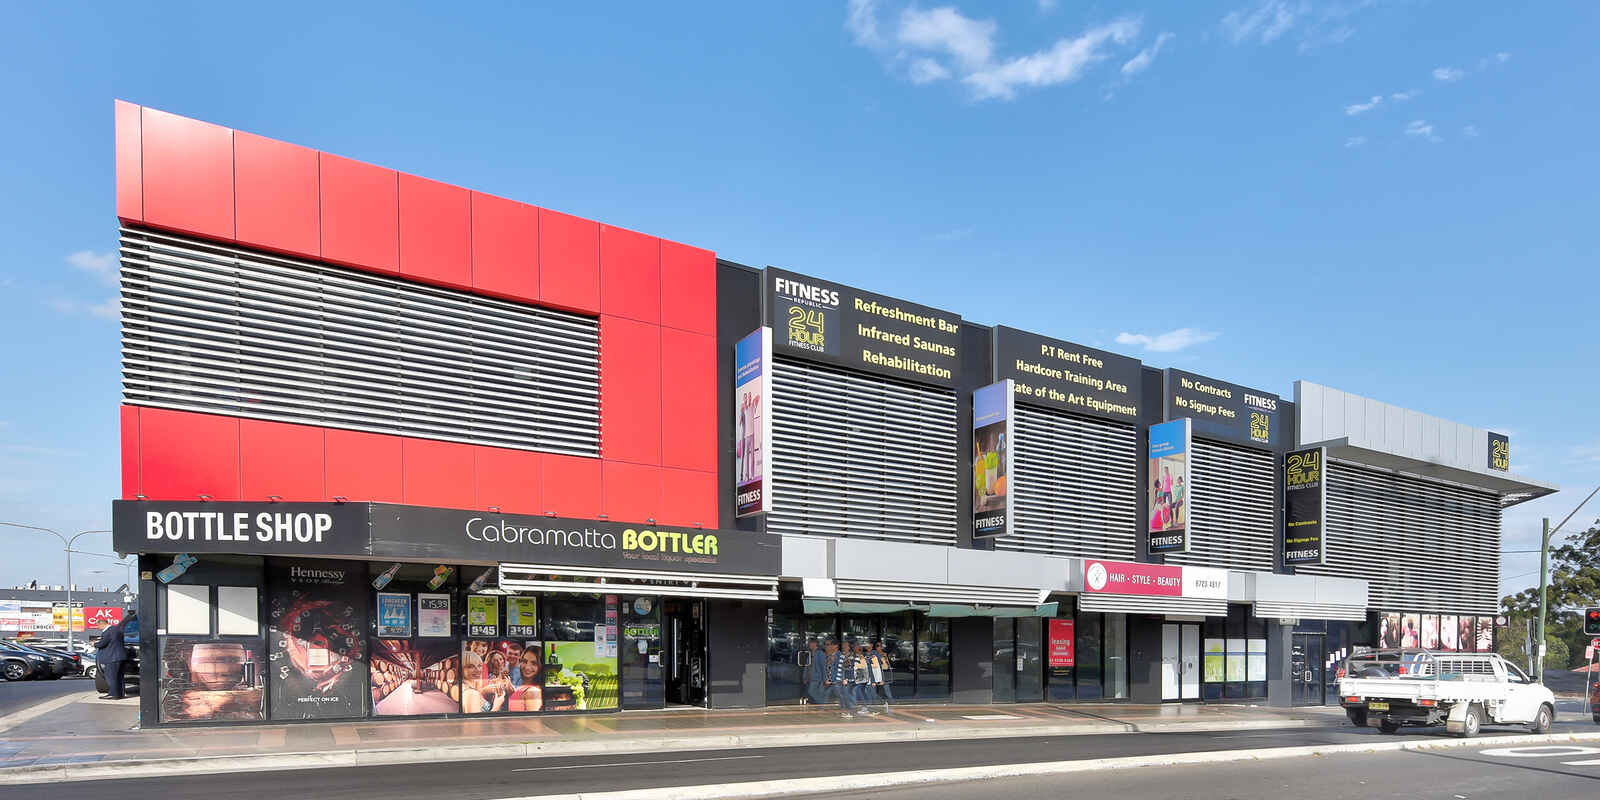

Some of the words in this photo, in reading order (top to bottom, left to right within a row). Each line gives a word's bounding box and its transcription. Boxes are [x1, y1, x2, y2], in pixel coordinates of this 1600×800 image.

[775, 277, 840, 306] FITNESS
[794, 298, 822, 308] REPUBLIC
[788, 306, 824, 334] 24
[854, 297, 937, 329] Refreshment
[938, 319, 959, 334] Bar
[788, 327, 824, 347] HOUR
[789, 340, 810, 351] FITNESS
[810, 344, 825, 353] CLUB
[858, 323, 911, 347] Infrared
[913, 337, 956, 357] Saunas
[863, 349, 952, 379] Rehabilitation
[1041, 344, 1056, 356] P.T
[1057, 348, 1081, 363] Rent
[1082, 354, 1104, 369] Free
[1016, 359, 1062, 379] Hardcore
[1064, 370, 1104, 390] Training
[1105, 380, 1128, 394] Area
[1181, 377, 1193, 389] No
[1194, 381, 1232, 399] Contracts
[1014, 383, 1032, 395] ate
[1034, 386, 1047, 397] of
[1048, 388, 1066, 402] the
[1068, 393, 1085, 406] Art
[1086, 397, 1137, 416] Equipment
[1175, 396, 1188, 407] No
[1189, 400, 1217, 416] Signup
[1218, 406, 1236, 418] Fees
[1244, 393, 1277, 411] FITNESS
[1250, 412, 1269, 431] 24
[1250, 427, 1269, 441] HOUR
[1493, 440, 1509, 459] 24
[1287, 451, 1320, 474] 24
[1287, 470, 1320, 486] HOUR
[737, 488, 761, 506] FITNESS
[146, 511, 250, 541] BOTTLE
[256, 512, 333, 543] SHOP
[975, 515, 1005, 529] FITNESS
[465, 517, 617, 550] Cabramatta
[622, 528, 719, 556] BOTTLER
[1151, 535, 1183, 546] FITNESS
[1286, 549, 1319, 559] FITNESS
[290, 566, 345, 581] Hennessy
[1109, 573, 1125, 583] HAIR
[1131, 575, 1151, 585] STYLE
[1157, 577, 1181, 588] BEAUTY
[96, 608, 113, 618] AK
